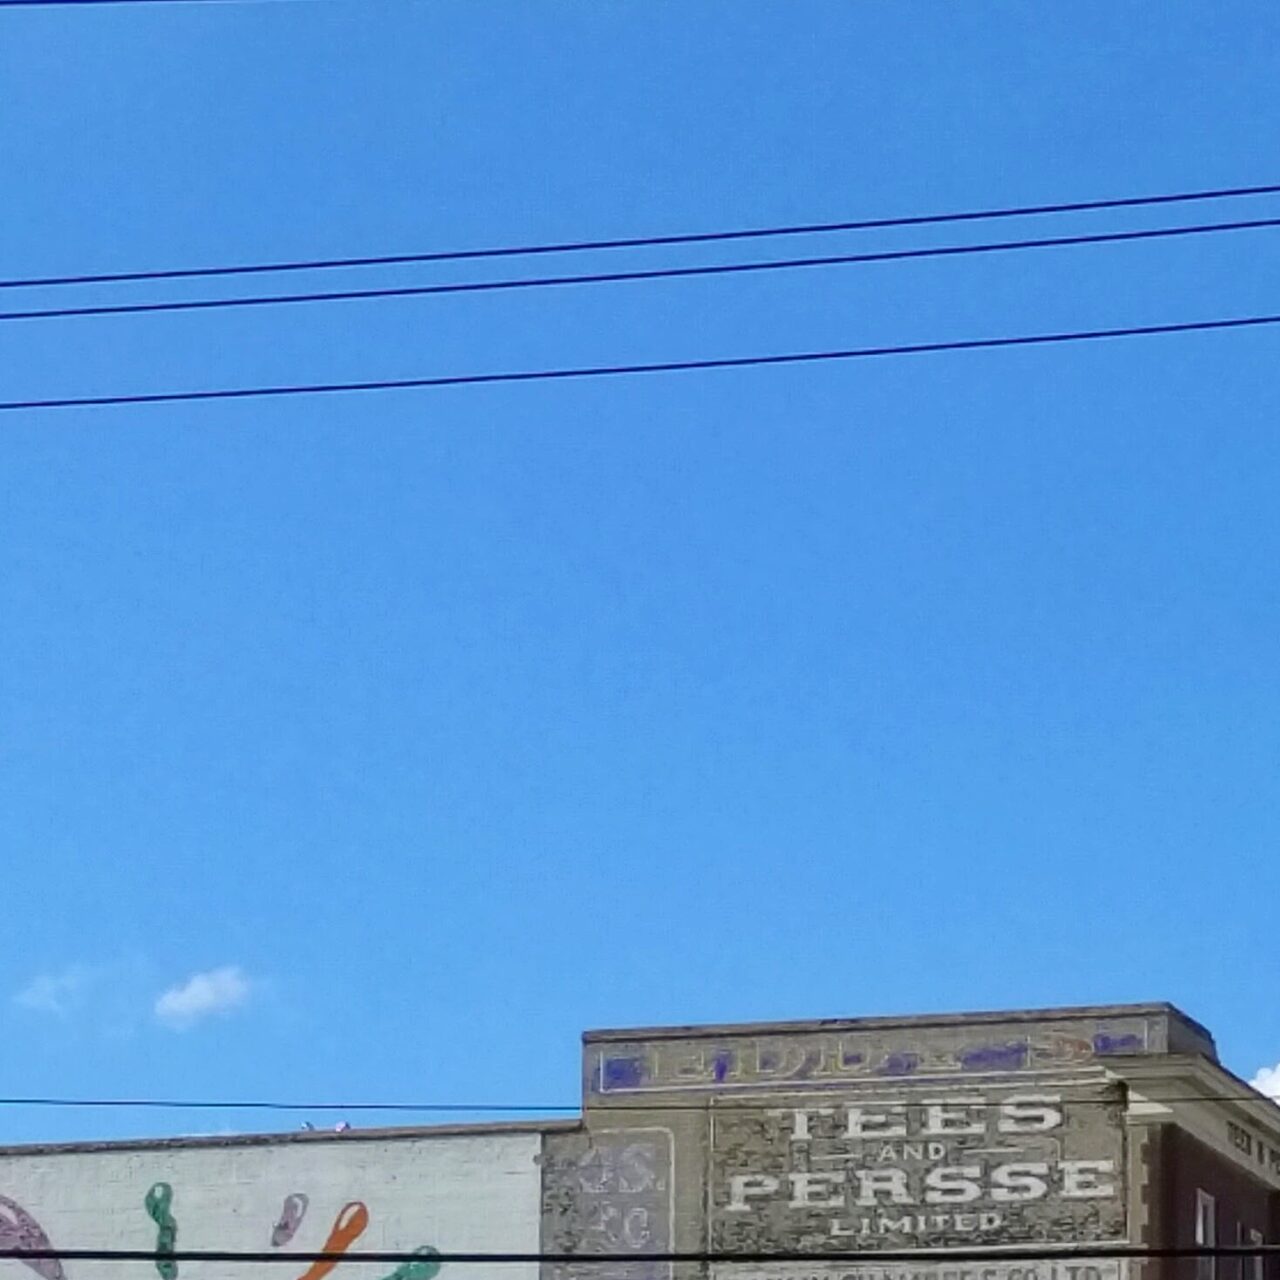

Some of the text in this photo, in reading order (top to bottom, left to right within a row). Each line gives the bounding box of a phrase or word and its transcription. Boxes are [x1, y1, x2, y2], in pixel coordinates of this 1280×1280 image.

[767, 1094, 1062, 1141] TEES
[878, 1142, 947, 1162] AND
[723, 1160, 1115, 1213] PERSSE
[829, 1213, 1002, 1236] LIMITED
